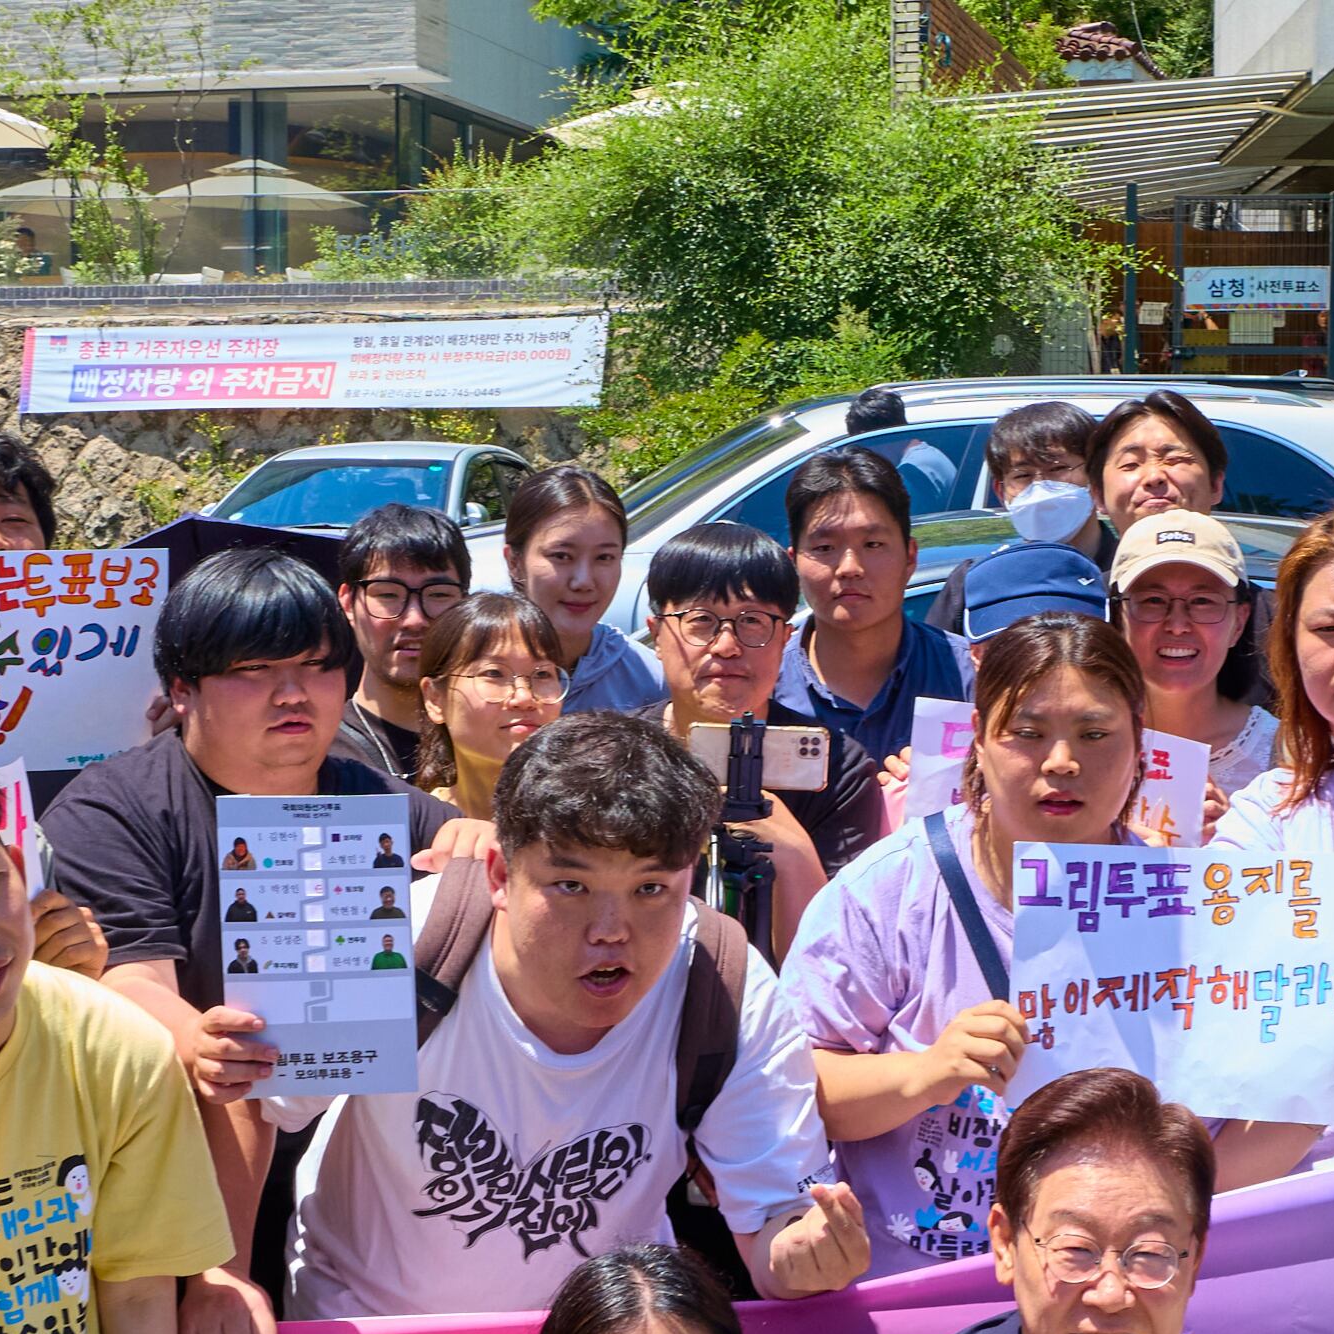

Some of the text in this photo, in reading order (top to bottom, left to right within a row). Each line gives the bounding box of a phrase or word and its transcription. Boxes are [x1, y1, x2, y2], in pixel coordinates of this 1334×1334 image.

[1208, 278, 1245, 298] 삼청
[1256, 280, 1320, 294] 사전투표소
[79, 337, 280, 360] 종로구 거주자우선 주차장
[447, 333, 501, 346] 배정차량만
[504, 332, 524, 344] 주차
[74, 365, 331, 398] 배정차량 외 주차금지
[28, 623, 141, 676] 있게
[1018, 858, 1322, 938] 그림투표 용지를
[276, 1050, 378, 1066] 림투표 보조용구
